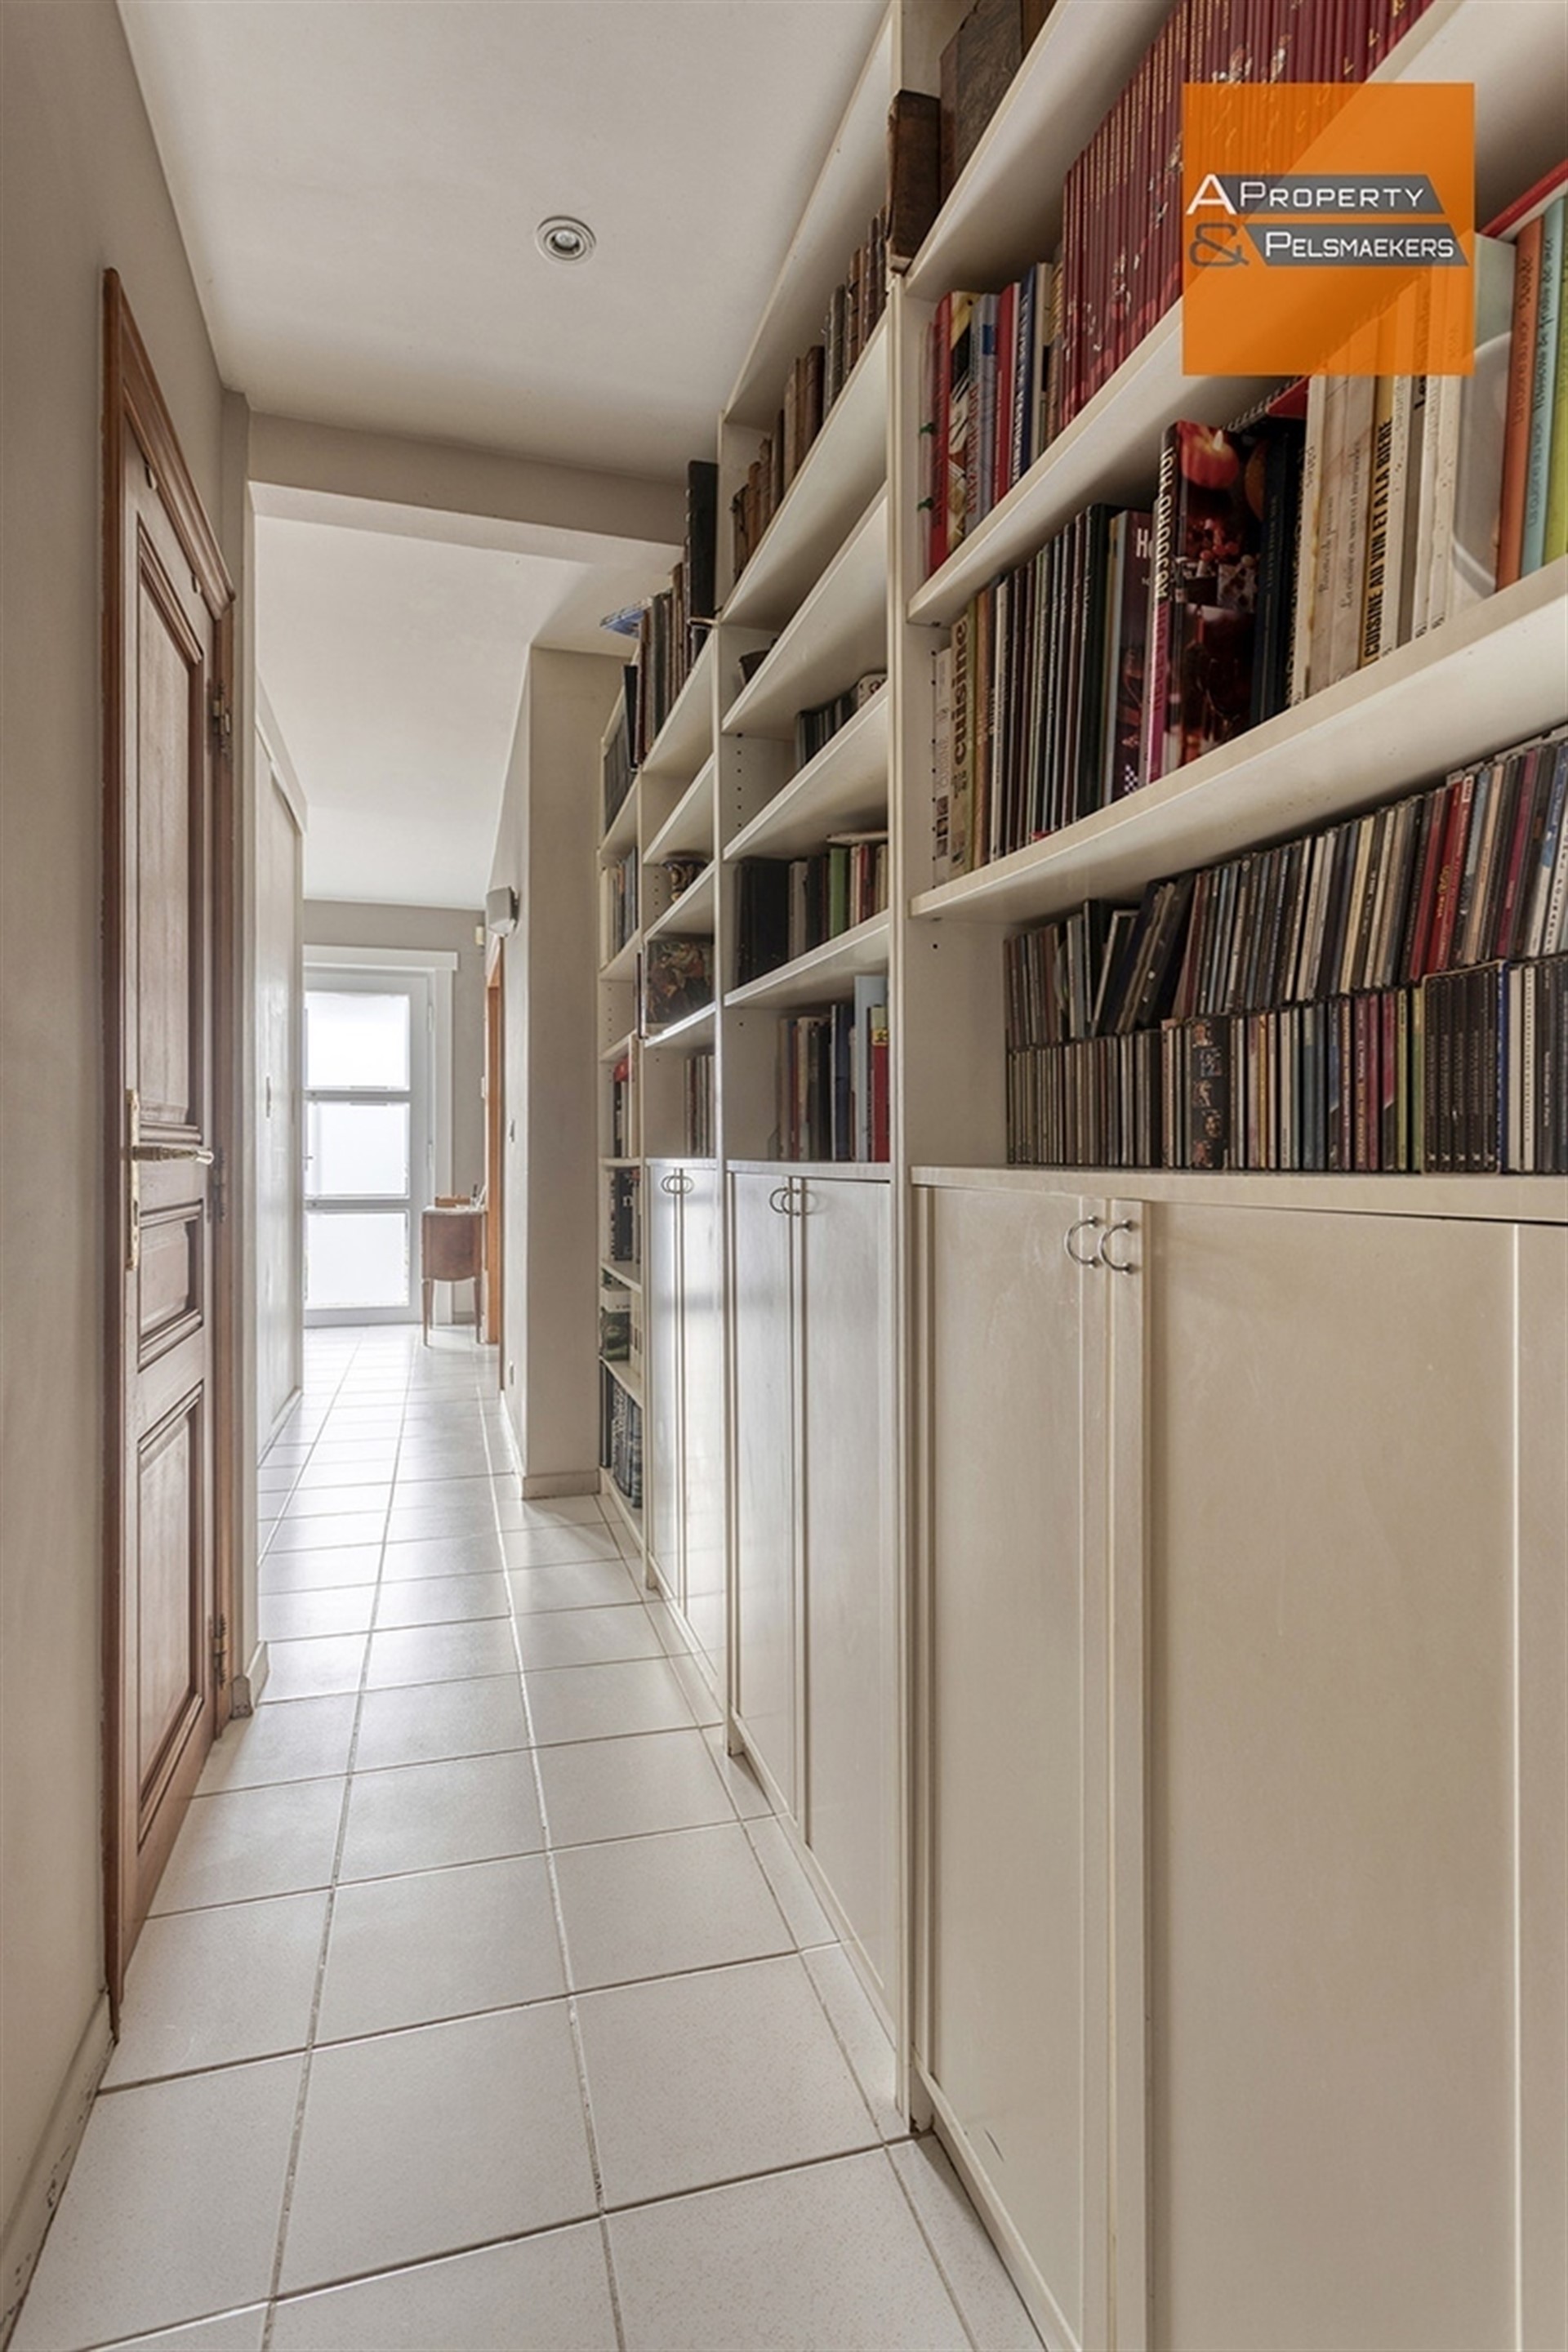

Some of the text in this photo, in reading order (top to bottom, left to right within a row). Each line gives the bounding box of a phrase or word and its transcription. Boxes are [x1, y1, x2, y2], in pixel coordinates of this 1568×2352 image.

[1376, 418, 1392, 468] BIERE
[1374, 468, 1390, 496] LA
[1373, 512, 1388, 532] ET
[1371, 531, 1386, 568] VIN
[1370, 569, 1385, 590] AU
[1365, 588, 1384, 657] CUISINE
[951, 621, 967, 765] cuisine
